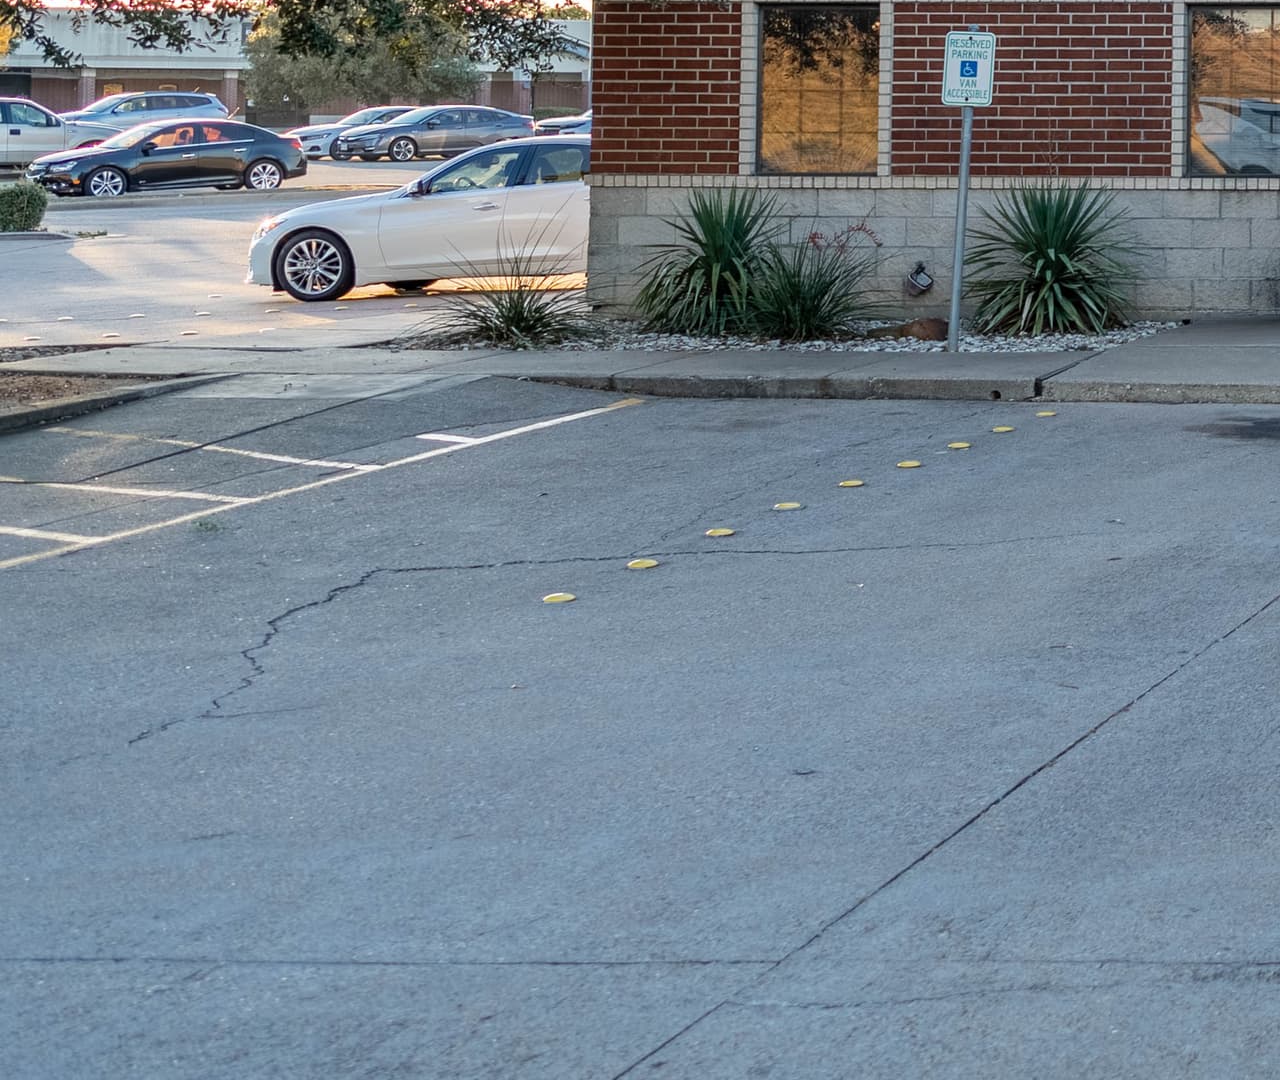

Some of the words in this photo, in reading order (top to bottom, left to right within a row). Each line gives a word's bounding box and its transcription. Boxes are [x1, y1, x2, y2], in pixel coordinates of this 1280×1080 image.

[950, 39, 991, 49] RESERVED
[952, 50, 988, 60] PARKING
[960, 79, 977, 88] VAN
[947, 89, 988, 99] ACCESSIBLE
